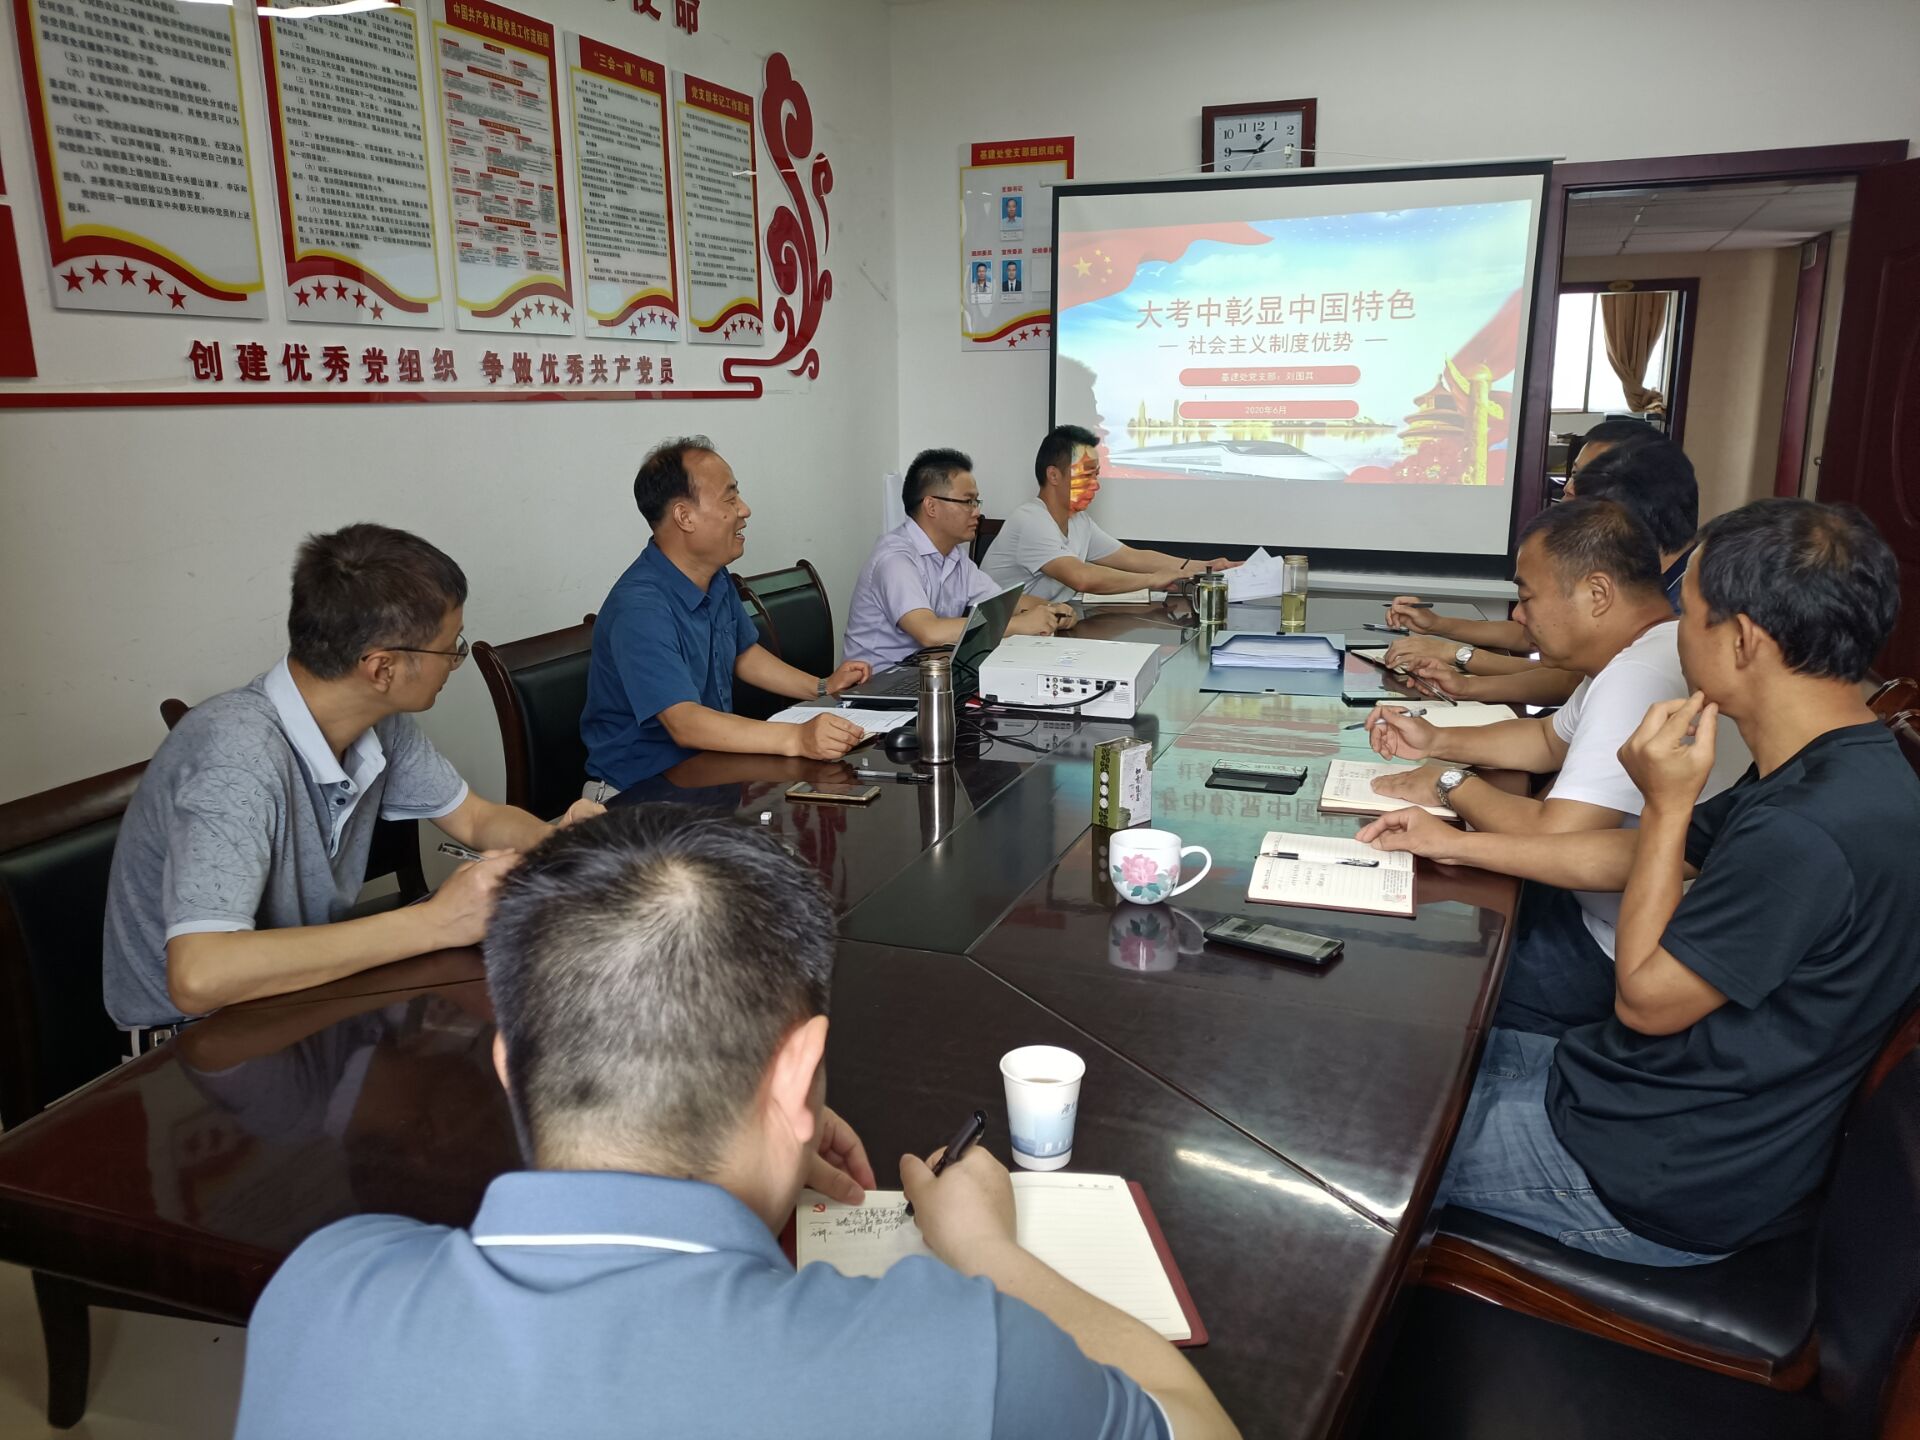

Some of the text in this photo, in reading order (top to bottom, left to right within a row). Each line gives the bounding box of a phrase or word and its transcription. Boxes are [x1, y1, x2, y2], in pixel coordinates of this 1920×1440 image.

[1253, 121, 1265, 132] 12
[1286, 125, 1295, 136] 2
[1224, 129, 1234, 139] 10
[980, 146, 1063, 159] 基建处党支部组织结构
[1224, 147, 1232, 158] 9
[1136, 288, 1417, 330] 大考中彰显中国特色
[1188, 331, 1354, 355] 社会主义制度优势
[188, 339, 675, 387] 创建优秀党组织 争做优秀共产党员
[1245, 405, 1287, 415] 2020年6月
